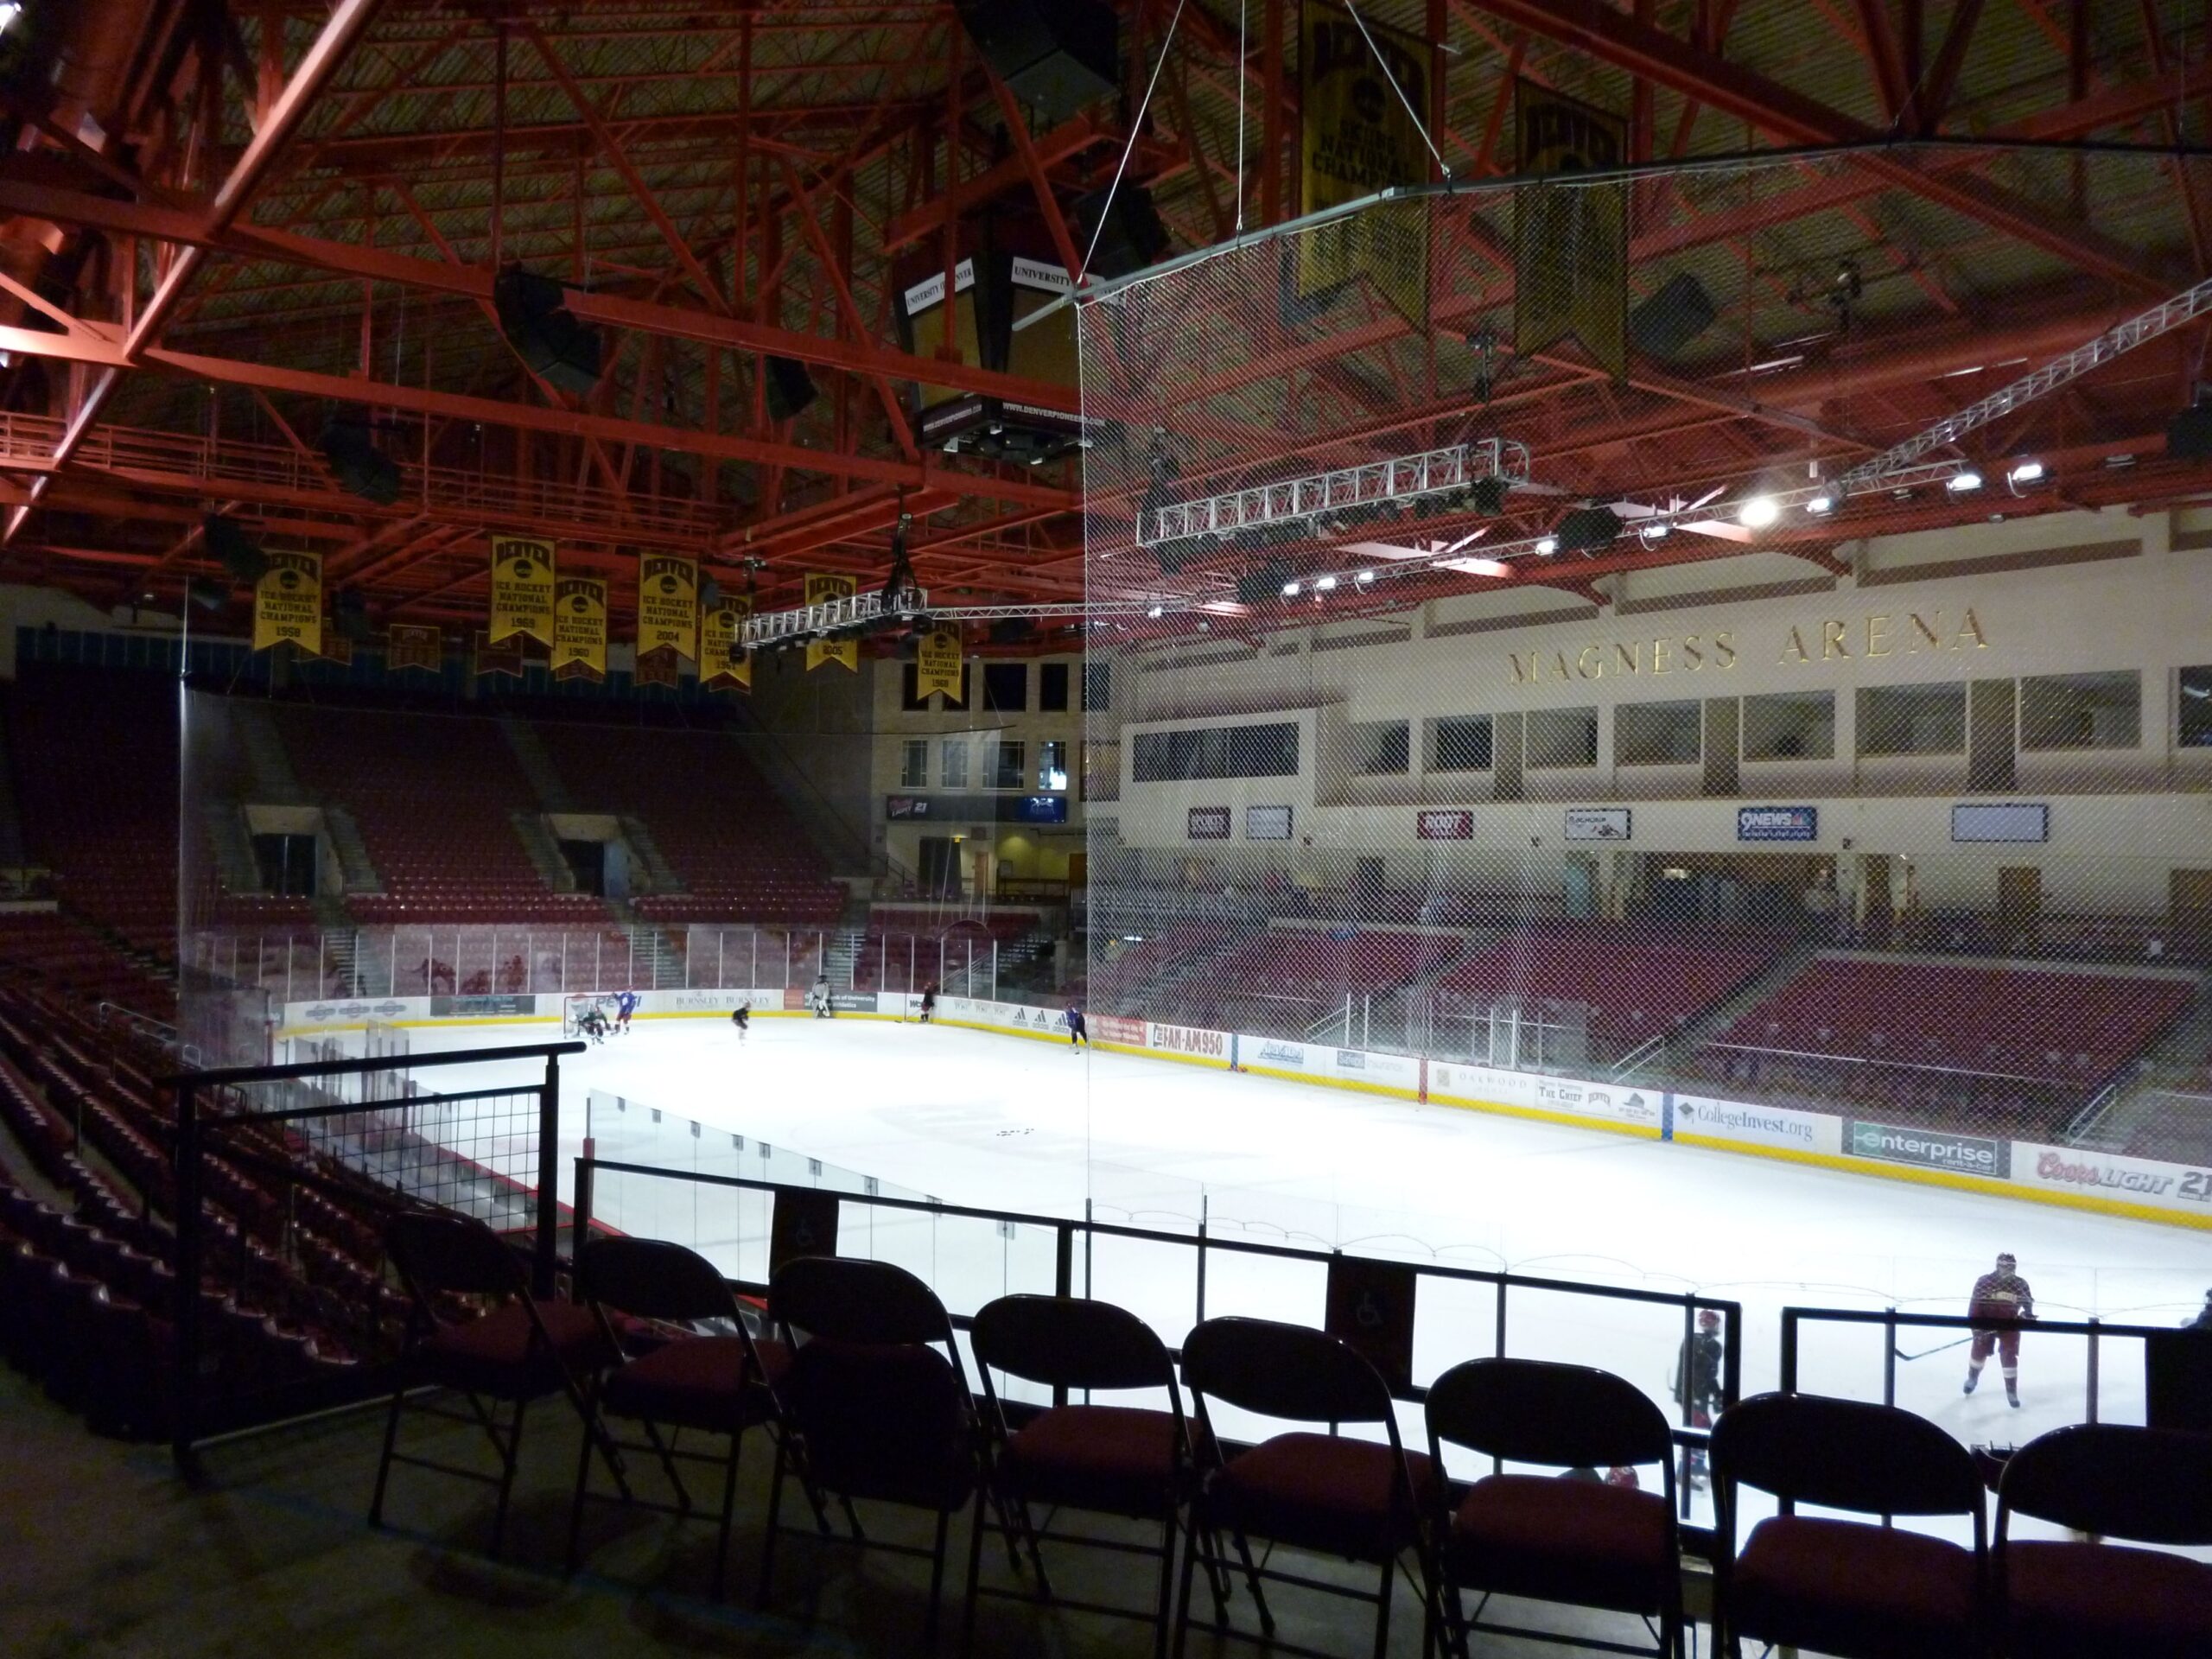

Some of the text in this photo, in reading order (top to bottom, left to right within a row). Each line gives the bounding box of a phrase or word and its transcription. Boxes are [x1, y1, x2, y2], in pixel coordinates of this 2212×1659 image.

[1014, 266, 1071, 287] UNIVERSITY
[496, 541, 551, 573] DENVER
[644, 558, 694, 589] DENVER
[496, 582, 552, 594] ICE HOCKEY
[808, 577, 854, 605] DENVER
[261, 591, 318, 603] ICE HOCKEY
[499, 593, 546, 603] NATIONAL
[556, 581, 604, 608] DENVER
[264, 601, 313, 613] NATIONAL
[643, 596, 693, 608] ICE HOCKEY
[497, 603, 550, 614] CHAMPIONS
[646, 607, 690, 619] NATIONAL
[261, 611, 317, 623] CHAMPIONS
[571, 617, 603, 626] HOCKEY
[642, 616, 693, 629] CHAMPIONS
[559, 625, 600, 635] NATIONAL
[704, 630, 716, 639] ICE
[656, 632, 680, 642] 2004
[823, 645, 843, 656] 2005
[1510, 607, 1989, 684] MAGNESS ARENA
[933, 652, 959, 660] HOCKEY
[924, 660, 957, 669] NATIONAL
[921, 669, 960, 677] CHAMPIONS
[914, 803, 927, 813] 21
[676, 996, 719, 1006] BURNSLEY
[1033, 1022, 1050, 1031] adidas
[1539, 1086, 1582, 1103] THE CHIEF
[1588, 1092, 1611, 1108] DENVER
[1698, 1102, 1813, 1141] CollegeInvest.org
[1861, 1133, 1993, 1164] enterprise
[2037, 1152, 2100, 1185] Coors
[2100, 1168, 2175, 1195] LIGHT
